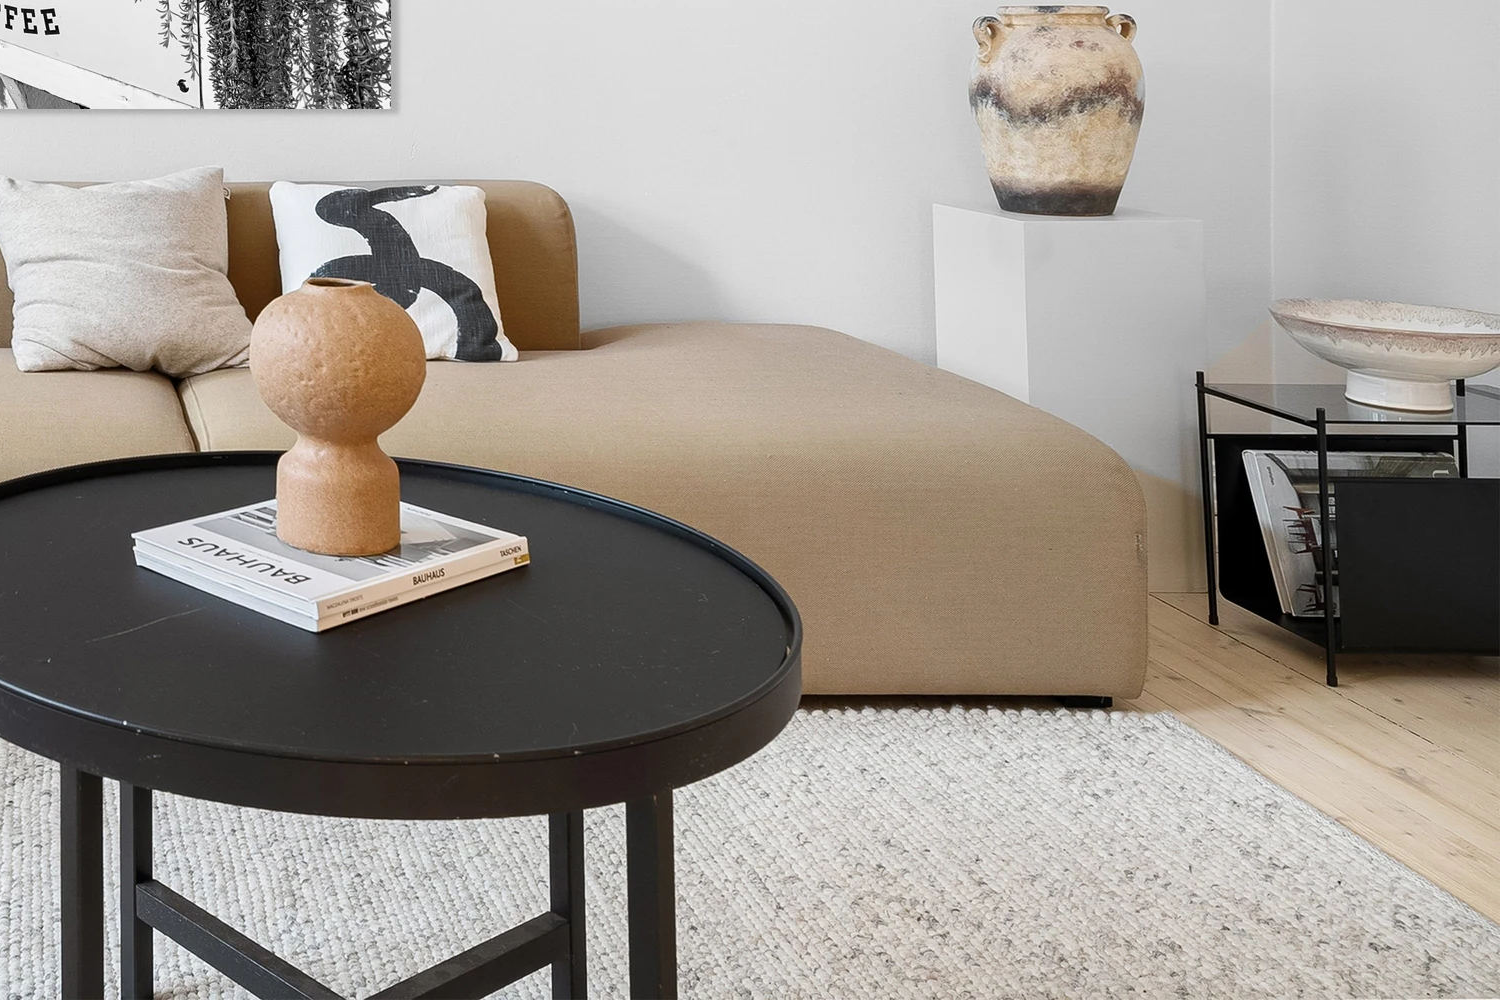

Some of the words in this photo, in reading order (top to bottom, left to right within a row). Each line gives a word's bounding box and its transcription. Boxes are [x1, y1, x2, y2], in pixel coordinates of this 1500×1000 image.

[177, 536, 312, 585] BAUHAUS
[500, 545, 522, 558] TASCHEN
[412, 567, 446, 586] BAUHAUS
